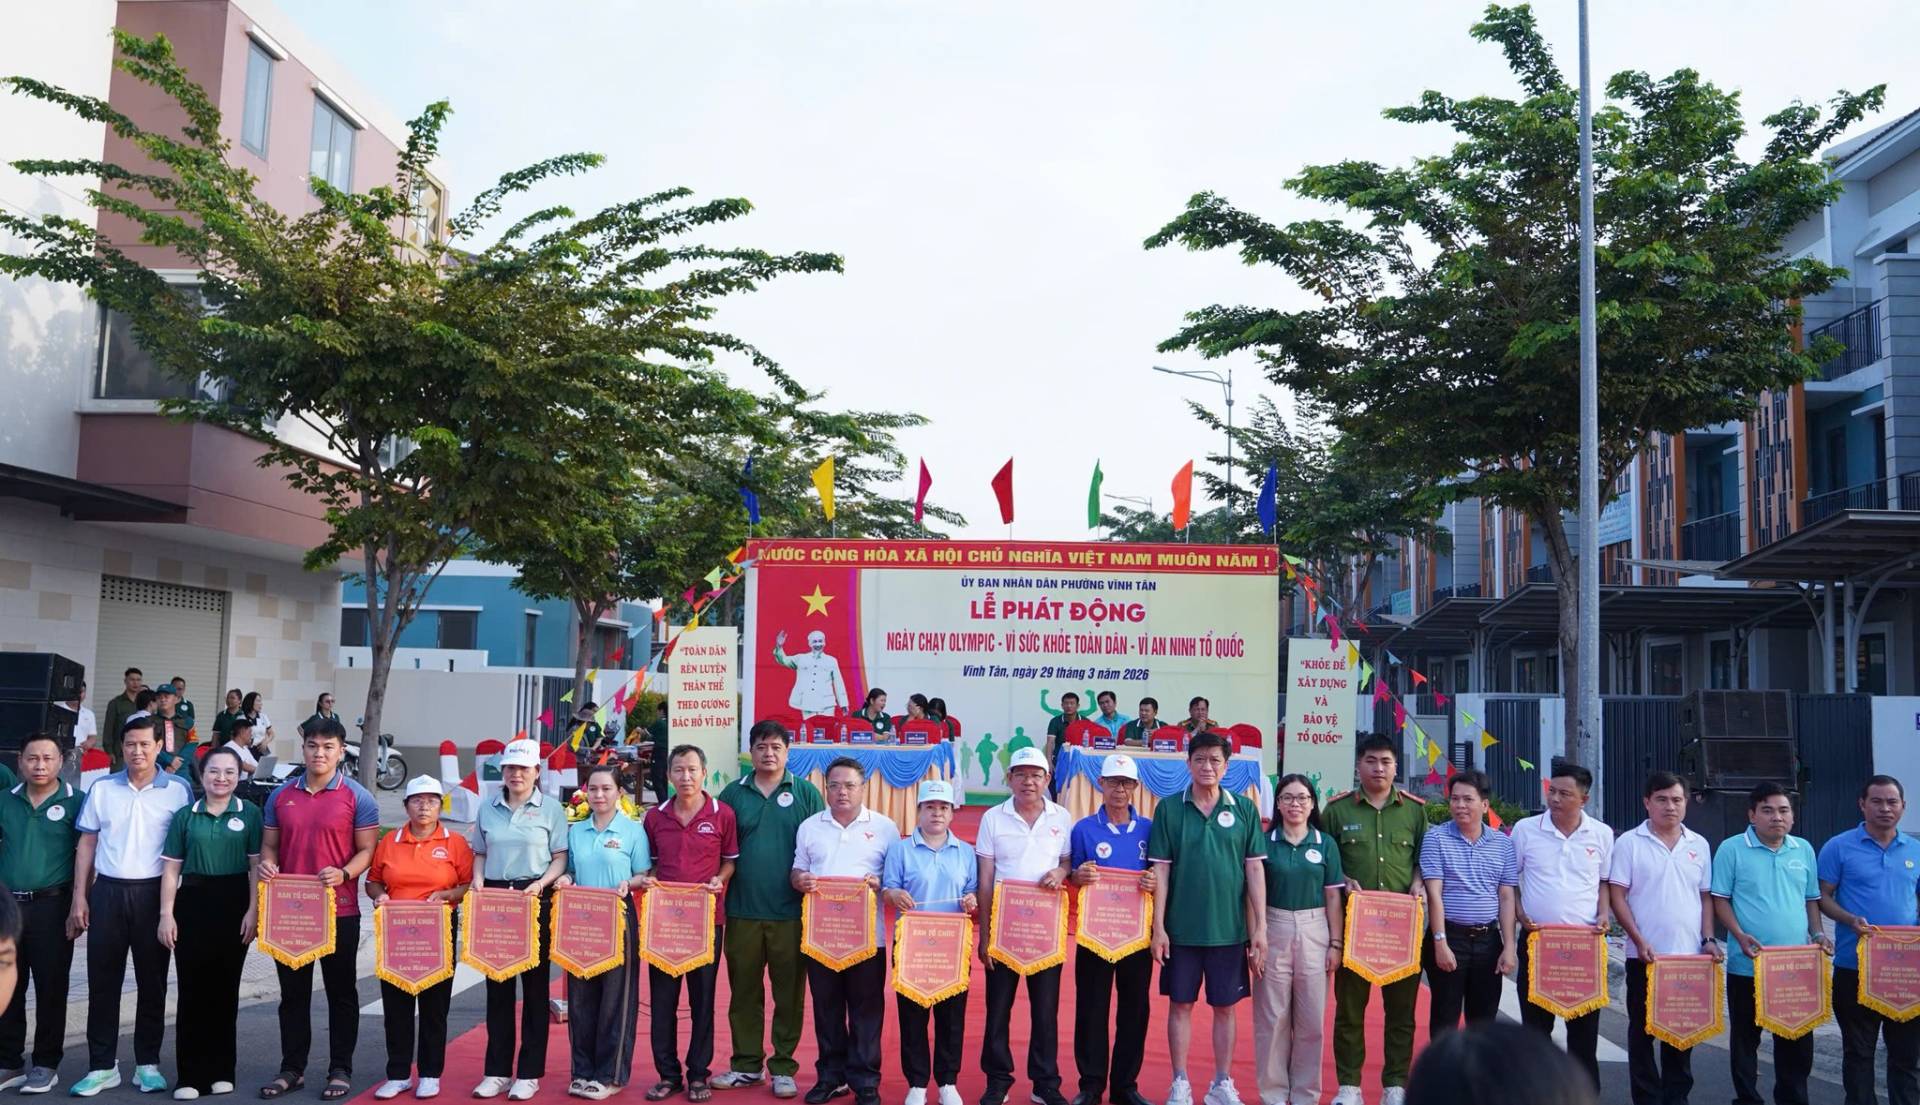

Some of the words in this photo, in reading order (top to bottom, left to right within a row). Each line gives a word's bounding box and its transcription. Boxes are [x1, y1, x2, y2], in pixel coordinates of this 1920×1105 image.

[811, 548, 858, 563] CỘNG
[864, 548, 898, 562] HÒA
[905, 548, 928, 562] XÃ
[934, 548, 962, 564] HỘI
[968, 548, 1003, 562] CHỦ
[1009, 549, 1063, 564] NGHĨA
[1068, 550, 1105, 566] VIỆT
[1111, 553, 1151, 565] NAM
[1158, 552, 1210, 566] MUÔN
[1216, 553, 1257, 567] NĂM
[961, 575, 975, 588] ỦY
[978, 579, 999, 588] BAN
[1003, 576, 1033, 588] NHÂN
[1036, 579, 1057, 589] DÂN
[1061, 579, 1104, 589] PHƯỜNG
[1108, 579, 1132, 590] VĨNH
[1136, 581, 1156, 591] TÂN
[971, 592, 996, 620] LỄ
[1003, 597, 1063, 620] PHÁT
[1070, 598, 1146, 627] ĐỘNG
[709, 645, 726, 655] DÂN
[887, 628, 915, 650] NGÀY
[919, 632, 946, 655] CHẠY
[950, 633, 994, 652] OLYMPIC
[1006, 630, 1015, 652] VÌ
[1019, 631, 1040, 653] SỨC
[1044, 628, 1071, 653] KHỎE
[1075, 632, 1101, 654] TOÀN
[1105, 633, 1127, 654] DÂN
[1138, 633, 1148, 655] VÌ
[1152, 637, 1166, 656] AN
[1170, 638, 1196, 656] NINH
[1199, 630, 1213, 656] TỔ
[1216, 632, 1243, 659] QUỐC
[681, 663, 697, 673] RÈN
[700, 663, 727, 676] LUYỆN
[1333, 656, 1345, 670] ĐỂ
[963, 665, 985, 677] Vĩnh
[989, 665, 1009, 678] Tân,
[1012, 667, 1038, 679] ngày
[1040, 667, 1053, 678] 29
[1056, 667, 1084, 680] tháng
[1088, 668, 1094, 679] 3
[1098, 667, 1120, 679] năm
[1123, 669, 1149, 680] 2026
[683, 680, 705, 691] THÂN
[708, 677, 724, 690] THỂ
[1298, 676, 1317, 687] XÂY
[1320, 678, 1347, 690] DỰNG
[677, 701, 698, 709] THEO
[701, 699, 730, 709] GƯƠNG
[1315, 695, 1328, 706] VÀ
[672, 716, 688, 727] BÁC
[691, 714, 702, 727] HỒ
[1303, 711, 1322, 724] BẢO
[1326, 714, 1337, 727] VỆ
[1297, 728, 1309, 742] TỔ
